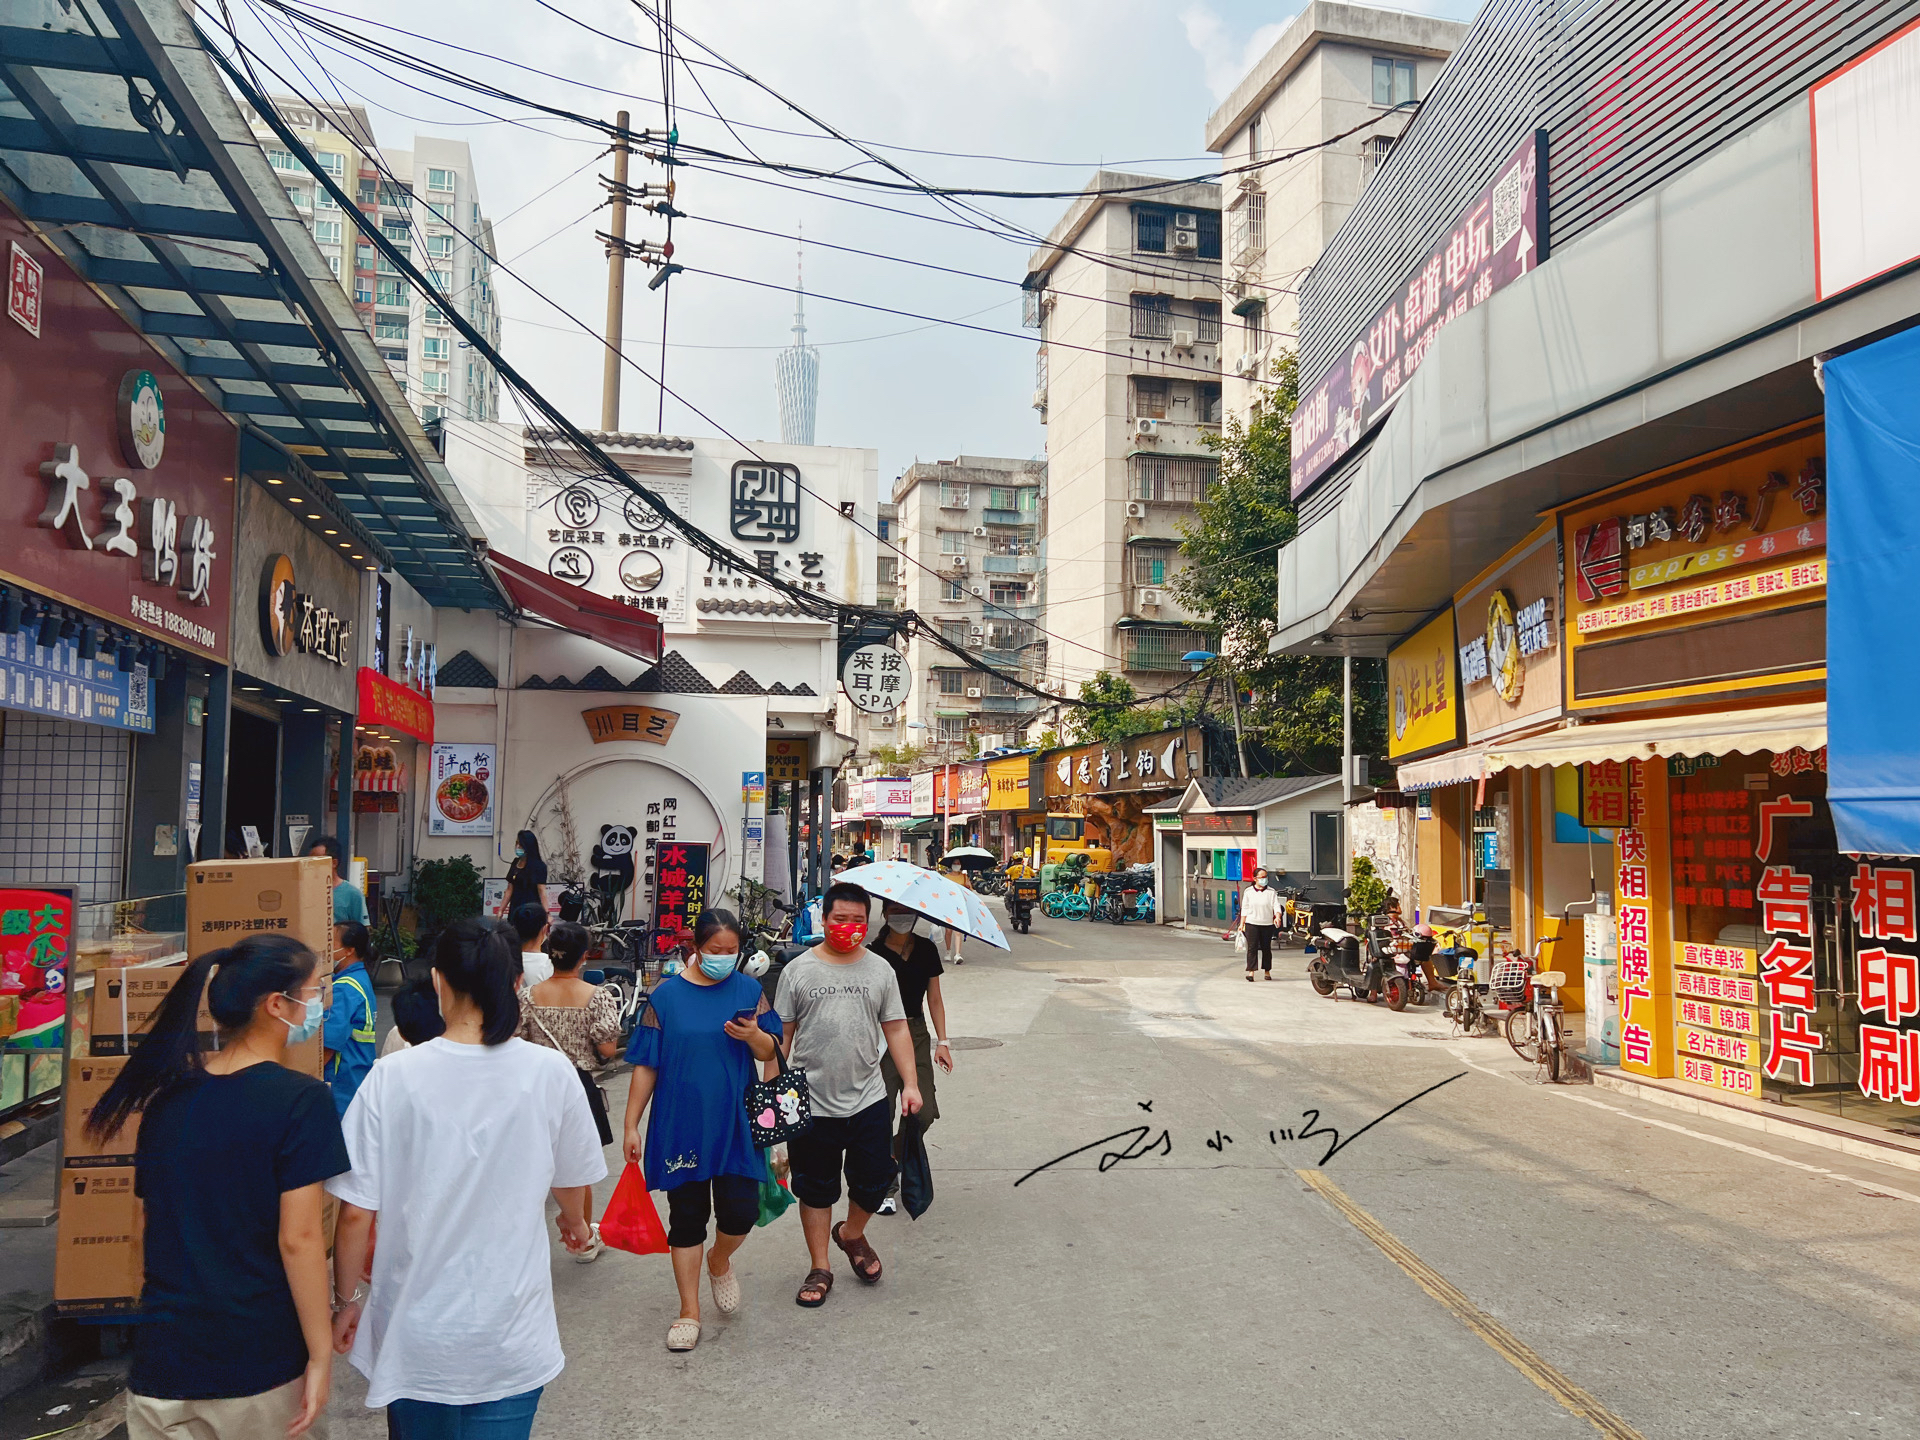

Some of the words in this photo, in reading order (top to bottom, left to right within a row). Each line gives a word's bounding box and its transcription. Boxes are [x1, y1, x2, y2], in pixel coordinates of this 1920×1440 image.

[1403, 253, 1442, 342] 桌游
[1445, 197, 1491, 291] 电玩
[54, 444, 216, 607] 大王鸭货
[547, 529, 605, 545] 艺匠采耳
[617, 533, 675, 549] 泰式鱼疗
[1635, 543, 1746, 581] express
[1759, 528, 1814, 555] 影像
[164, 610, 216, 649] 18838047804
[300, 594, 349, 667] 茶理宜世
[1516, 597, 1546, 634] SHRIMP
[859, 694, 894, 708] SPA
[1409, 647, 1447, 726] 粒上皇
[597, 713, 668, 738] 川耳艺
[1076, 749, 1155, 788] 愿者上钩
[1699, 757, 1718, 767] 103
[1715, 864, 1751, 883] PVC卡
[687, 874, 704, 932] 24小时不
[202, 918, 289, 933] 透明PP注塑杯套
[1755, 794, 1822, 1087] 广告名片
[1684, 945, 1745, 969] 宣传单张
[127, 980, 169, 990] 茶百道
[809, 986, 836, 998] GOD
[843, 986, 870, 998] WAR
[1678, 973, 1754, 1002] 高精度喷画
[1850, 853, 1920, 1107] 相印刷
[1683, 1001, 1711, 1025] 横幅
[1719, 1007, 1751, 1032] 锦旗
[1687, 1031, 1748, 1061] 名片制作
[1684, 1060, 1714, 1083] 刻章
[1721, 1067, 1753, 1093] 打印
